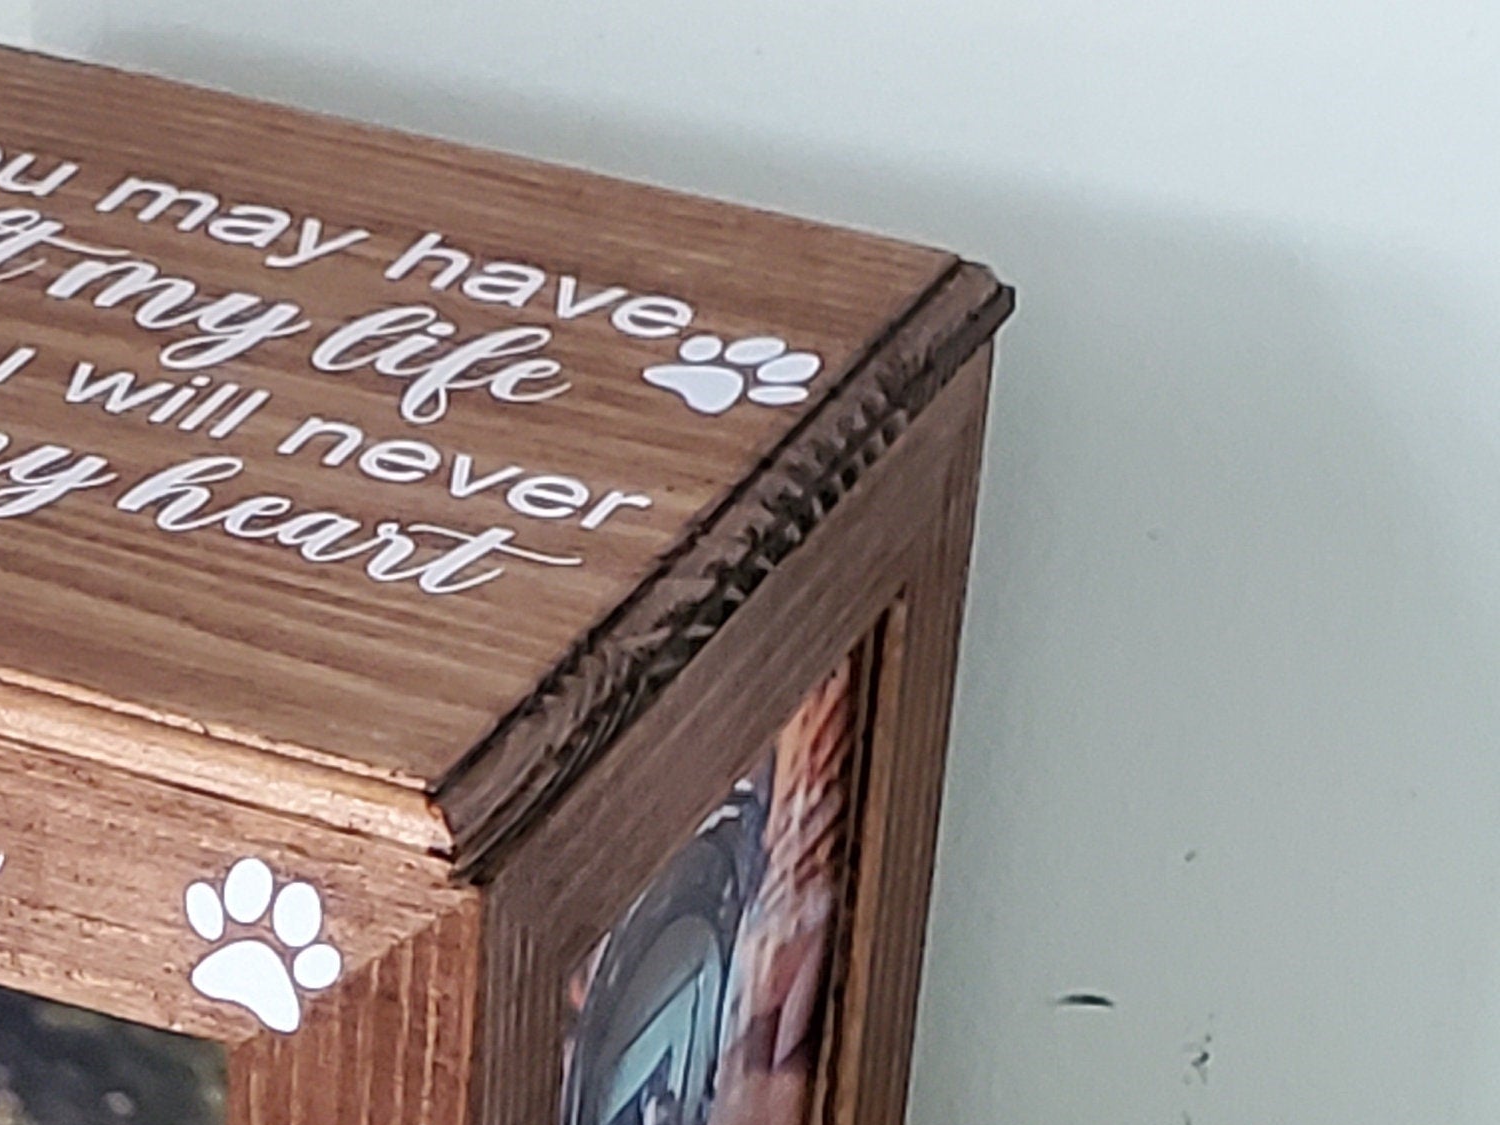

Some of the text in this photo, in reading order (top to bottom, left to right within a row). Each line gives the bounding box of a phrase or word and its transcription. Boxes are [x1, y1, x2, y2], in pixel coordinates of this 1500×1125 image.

[95, 177, 370, 270] may
[383, 232, 695, 339] have
[45, 257, 314, 371] my
[309, 304, 574, 426] life
[64, 361, 272, 441] will
[276, 416, 655, 533] never
[115, 454, 586, 599] heart
